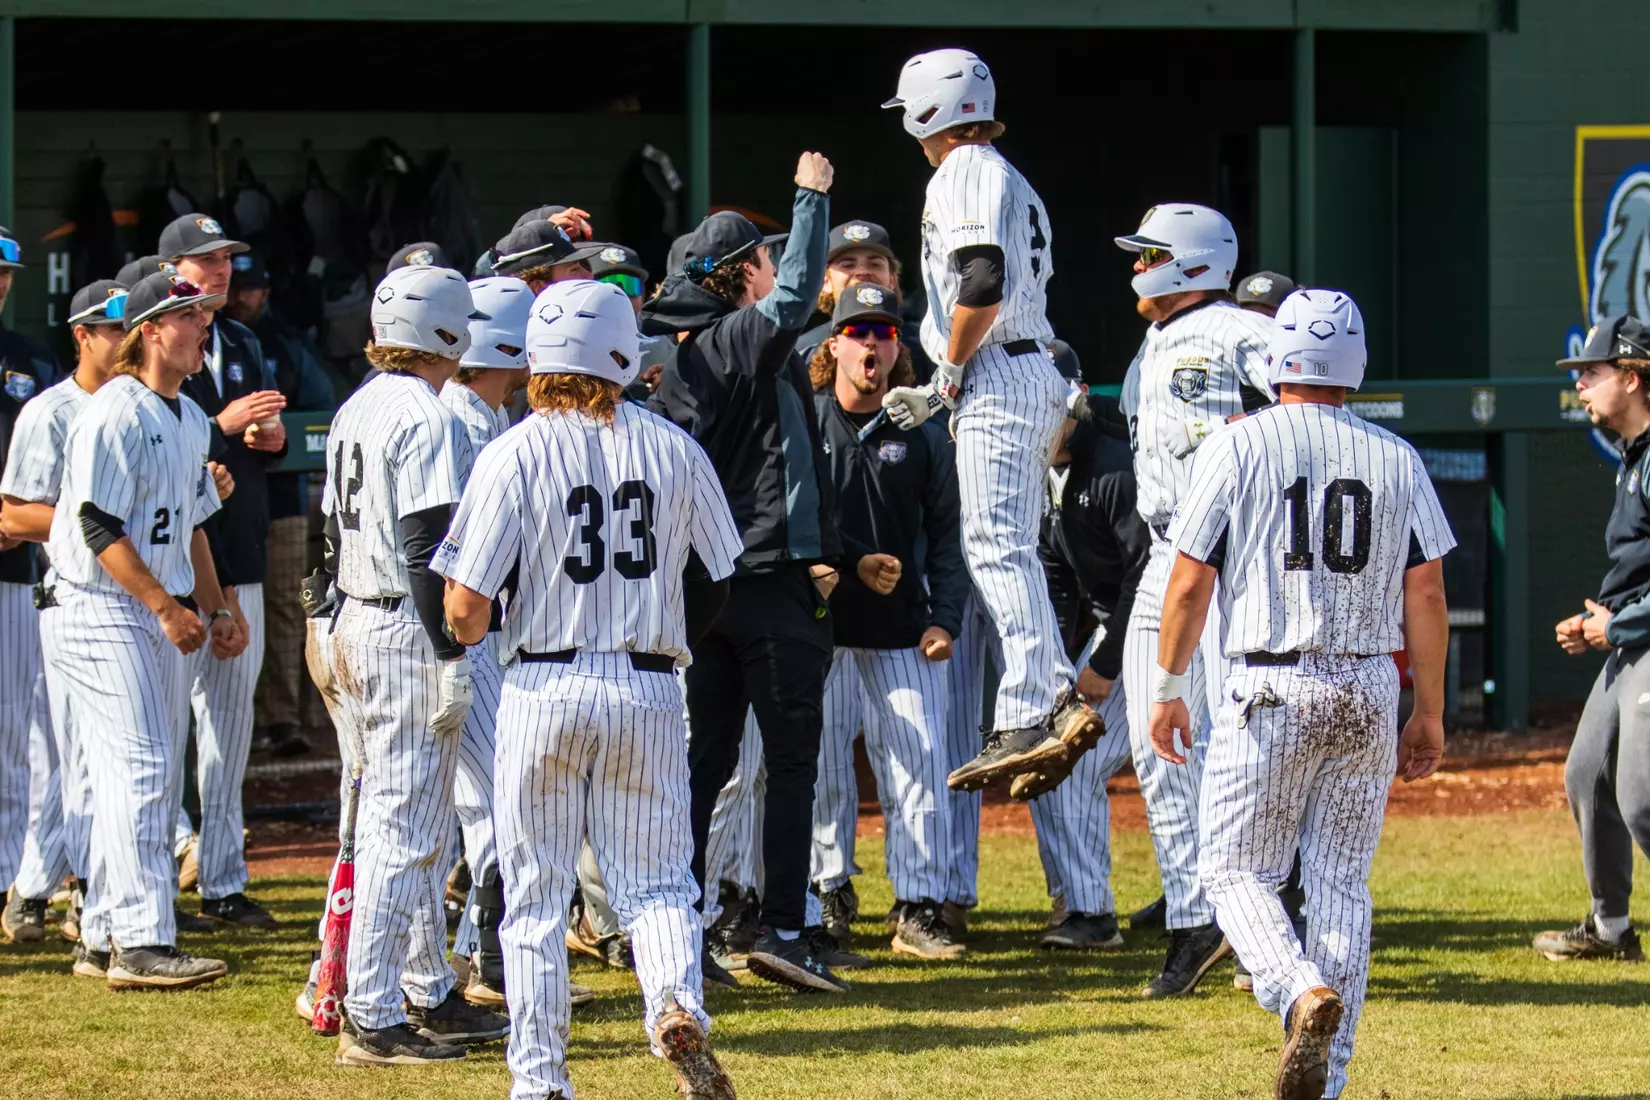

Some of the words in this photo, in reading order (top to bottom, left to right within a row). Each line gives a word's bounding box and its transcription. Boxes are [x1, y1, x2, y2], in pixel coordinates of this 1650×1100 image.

[951, 224, 985, 234] HORIZON
[1313, 362, 1328, 376] 10
[564, 479, 657, 584] 33
[1283, 476, 1373, 575] 10
